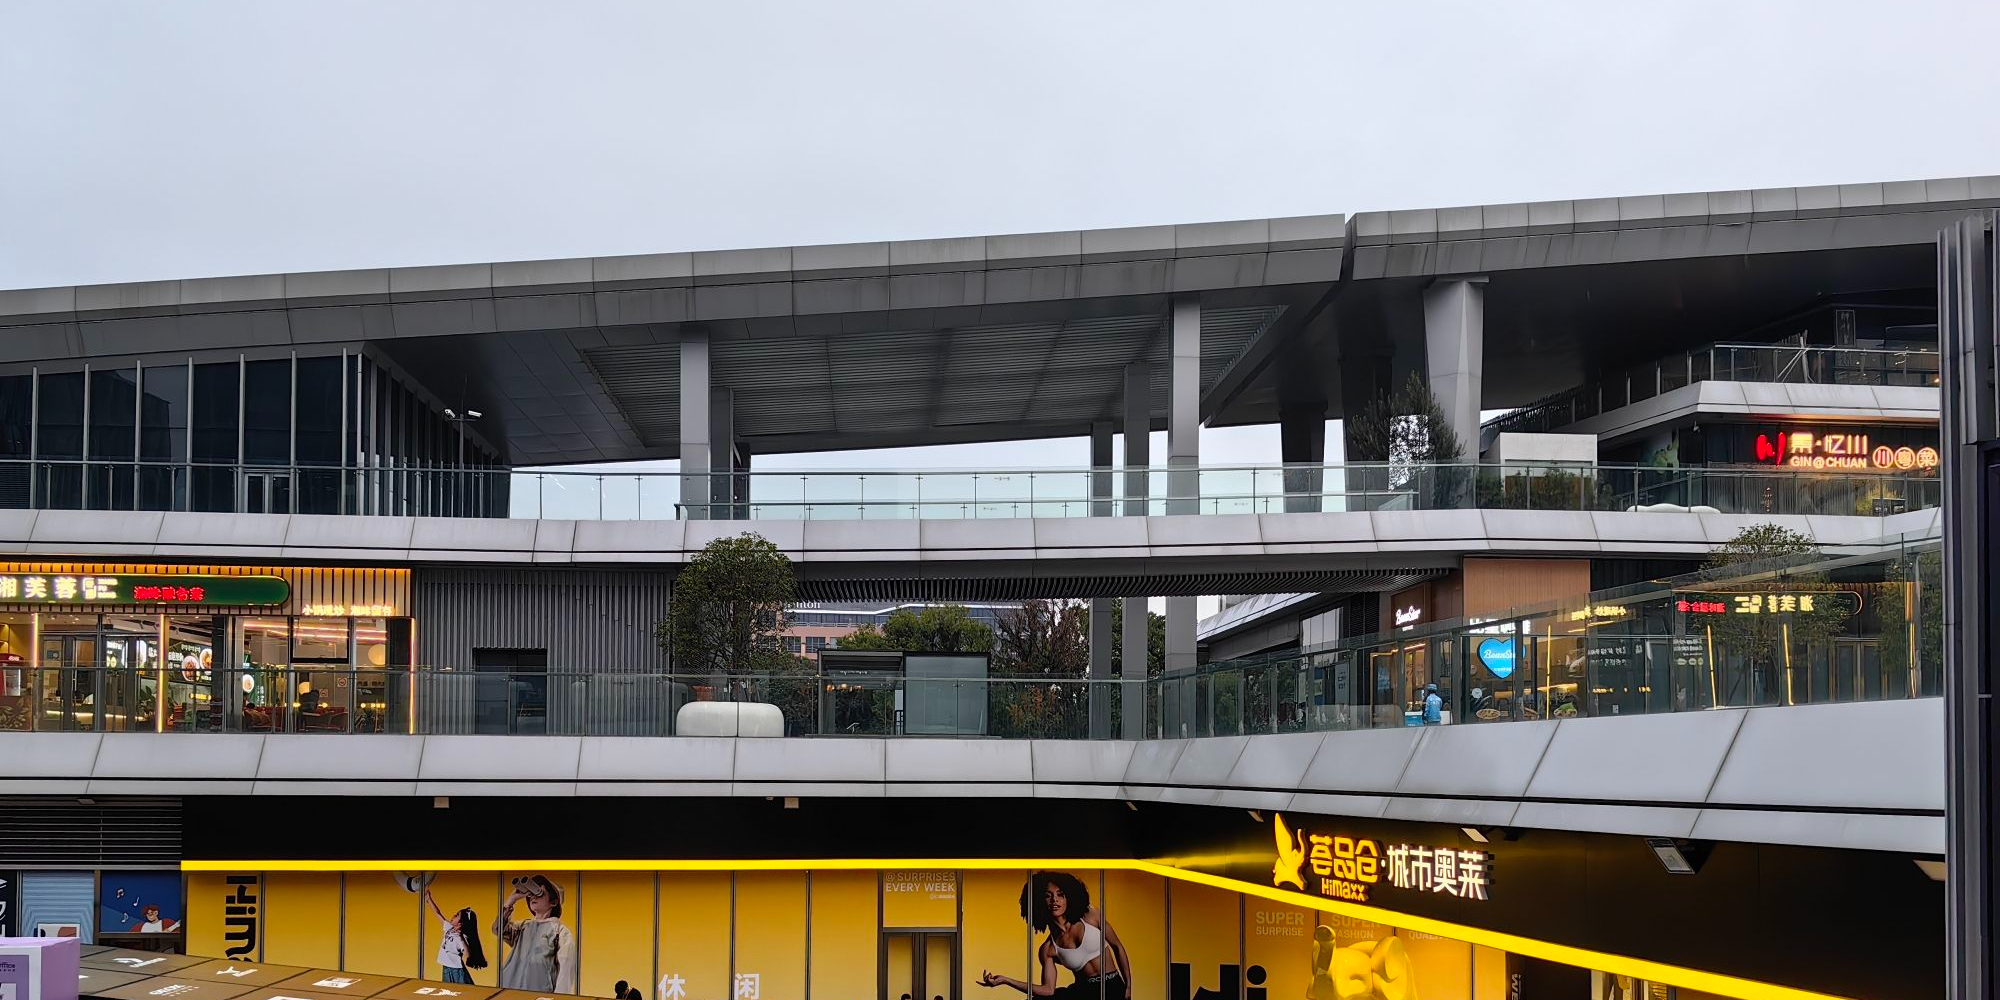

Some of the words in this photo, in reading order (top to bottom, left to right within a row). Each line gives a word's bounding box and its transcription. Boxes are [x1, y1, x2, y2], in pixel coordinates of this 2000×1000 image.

[1790, 456, 1868, 469] GIN@CHUAN
[886, 883, 920, 892] EVERY
[925, 883, 956, 892] WEEK
[1322, 877, 1369, 902] Himaxx
[1256, 911, 1305, 925] SUPER
[1256, 926, 1303, 937] SURPRISE
